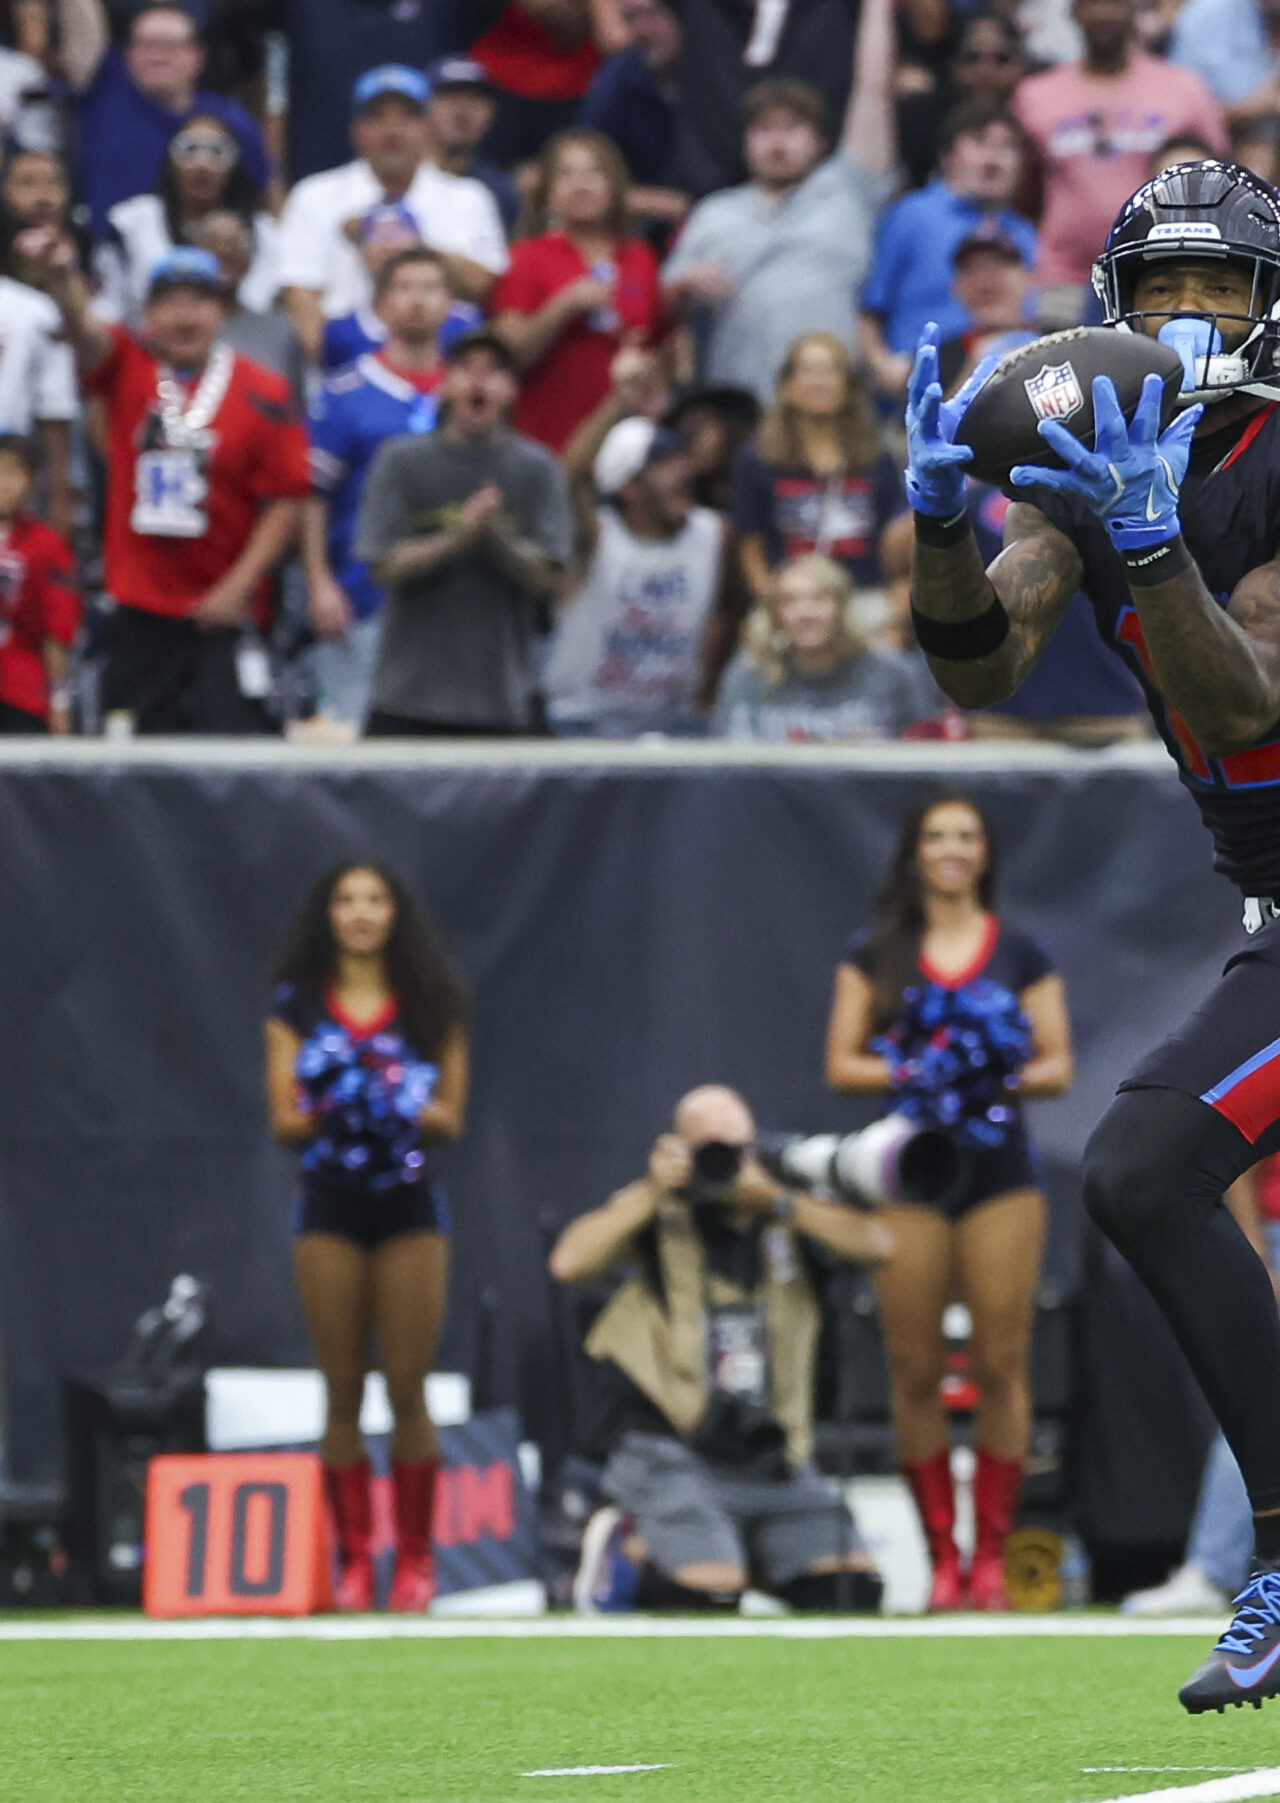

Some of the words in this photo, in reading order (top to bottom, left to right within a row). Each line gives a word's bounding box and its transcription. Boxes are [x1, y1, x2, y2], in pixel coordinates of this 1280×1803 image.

[1155, 227, 1213, 235] TEXANS
[1039, 385, 1078, 418] NFL
[180, 1482, 288, 1597] 10
